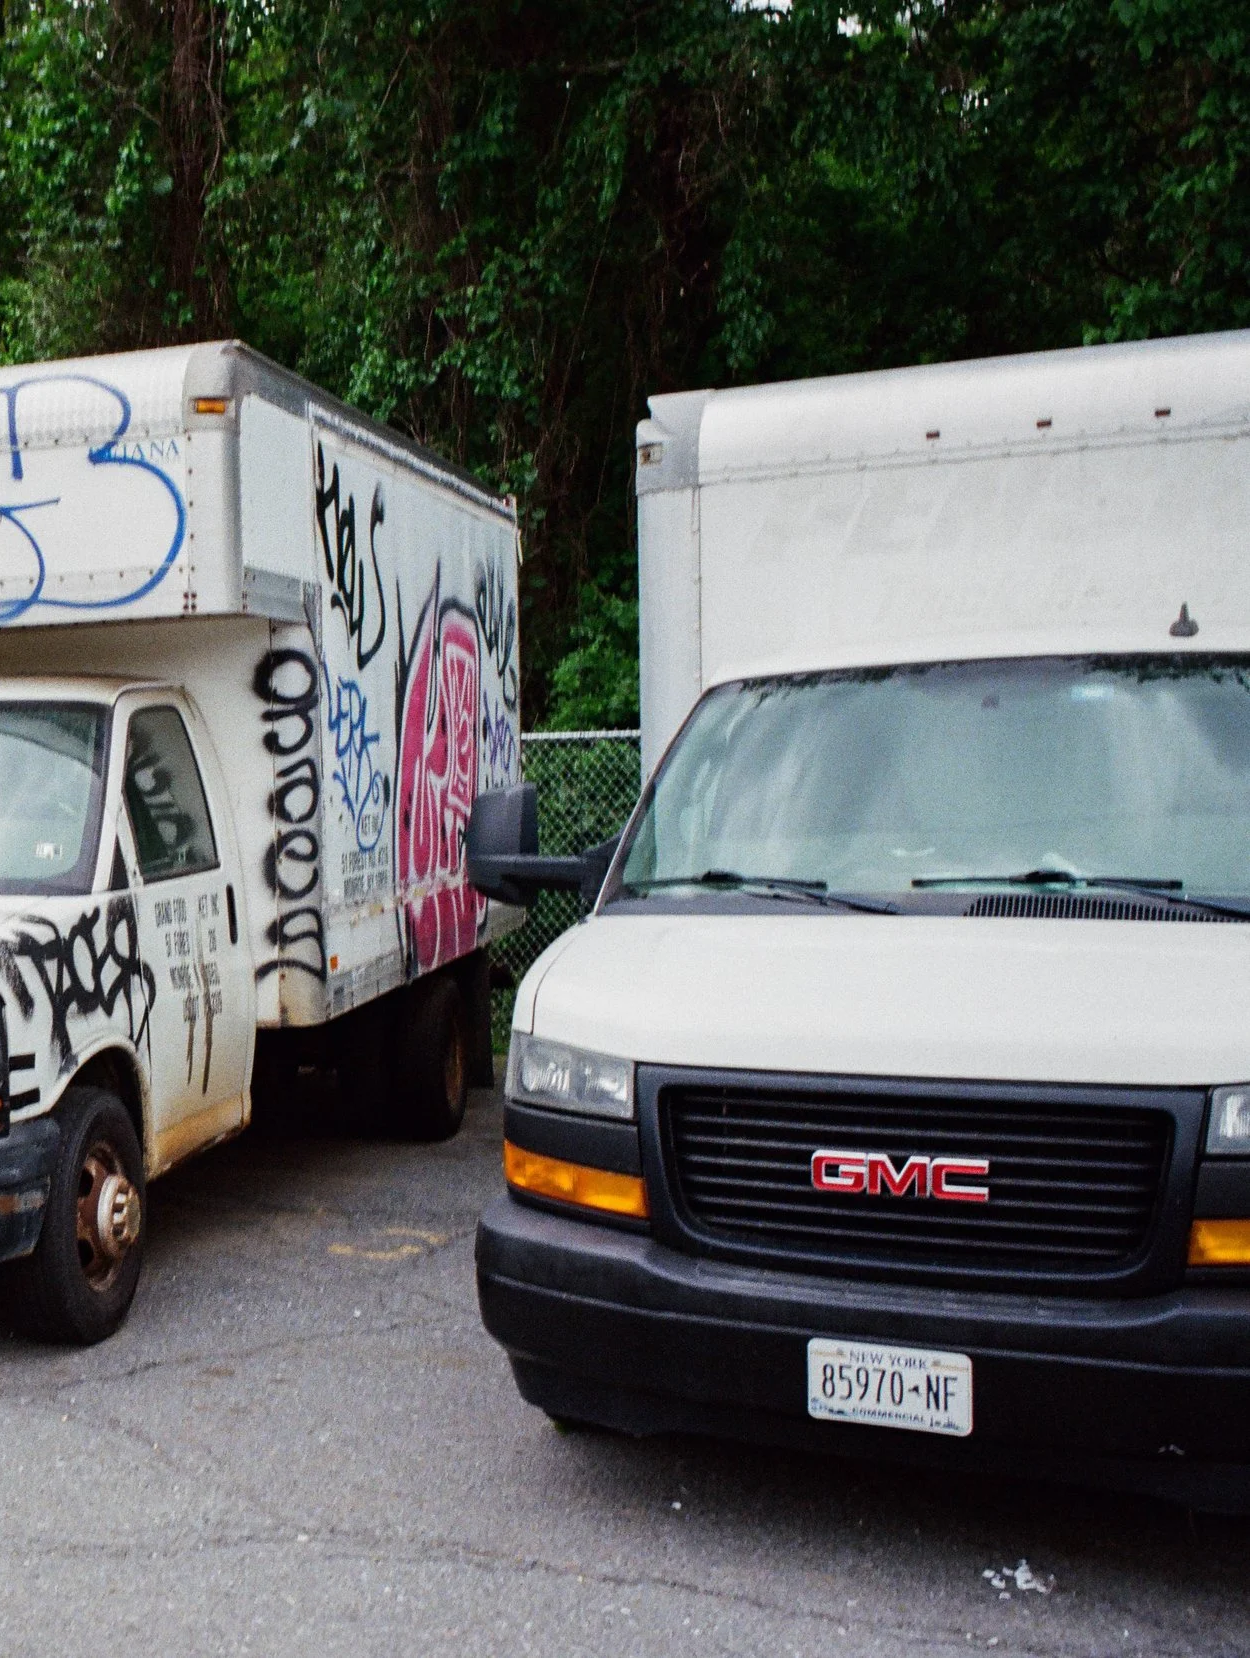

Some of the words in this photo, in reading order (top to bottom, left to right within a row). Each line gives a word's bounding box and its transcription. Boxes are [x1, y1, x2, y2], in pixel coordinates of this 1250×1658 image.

[811, 1150, 990, 1203] GMC
[849, 1349, 884, 1366] NEW
[888, 1352, 928, 1370] YORK
[822, 1363, 904, 1407] 85970
[926, 1373, 958, 1412] NF
